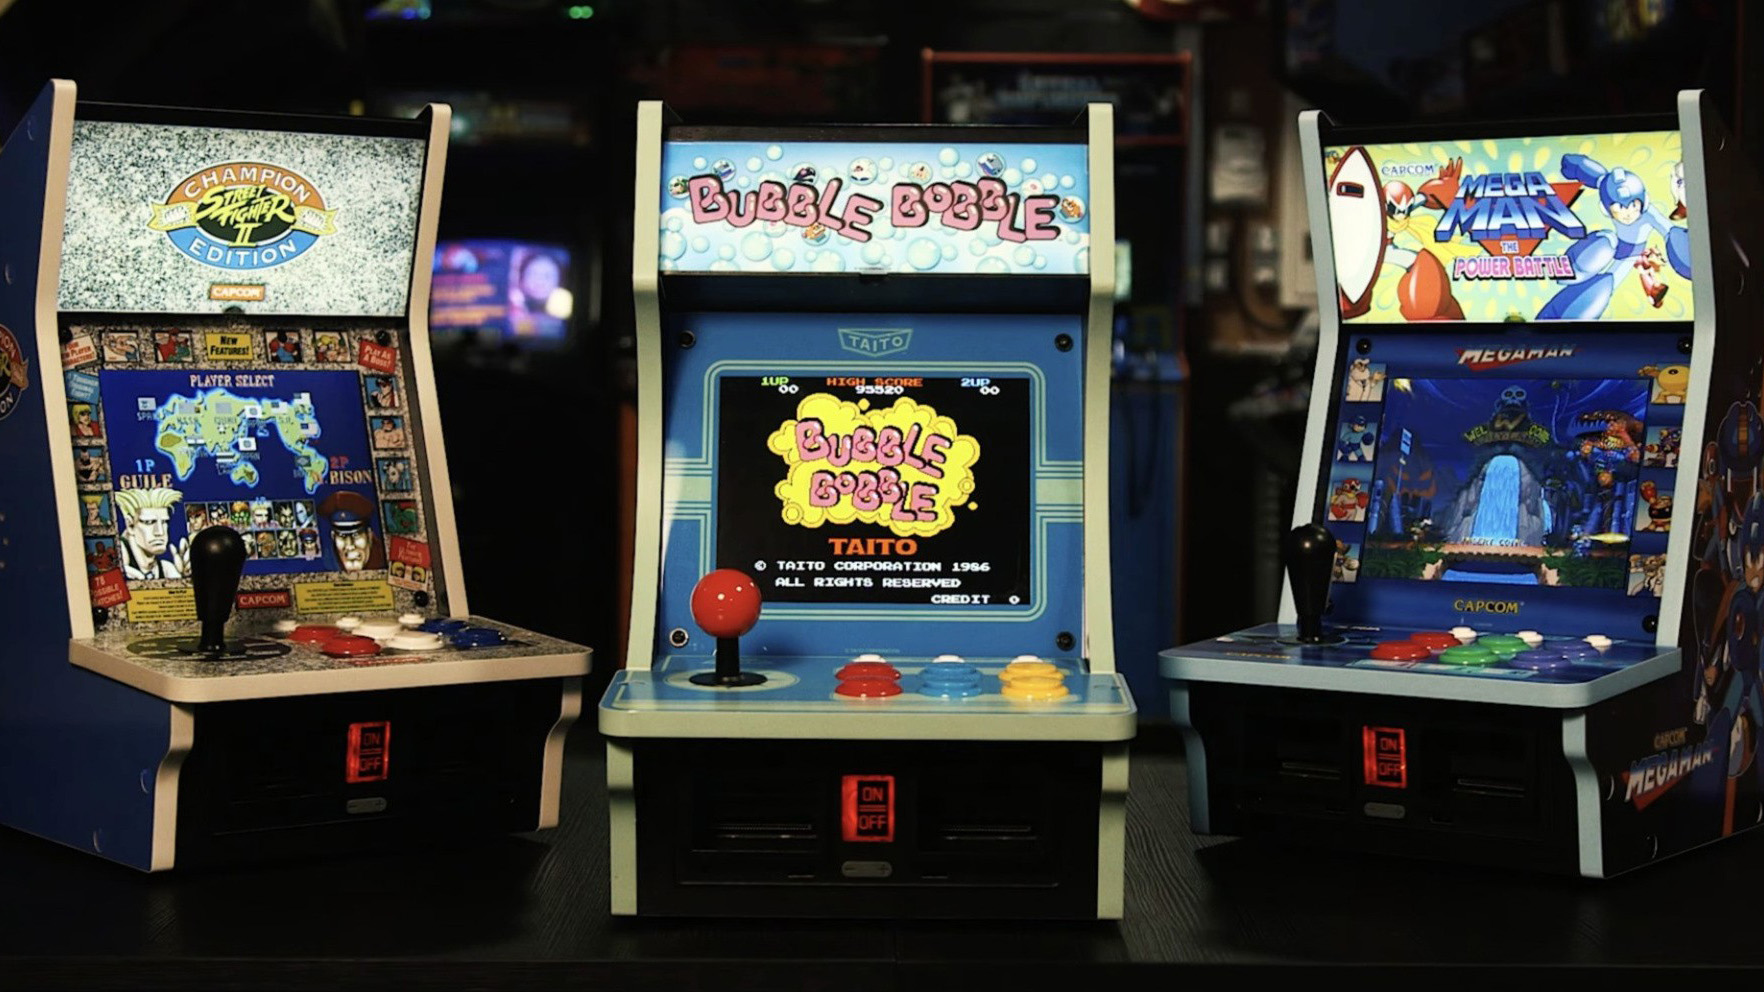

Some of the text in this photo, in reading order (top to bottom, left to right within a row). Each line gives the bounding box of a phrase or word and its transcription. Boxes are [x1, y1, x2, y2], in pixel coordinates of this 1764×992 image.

[1381, 162, 1435, 177] CAPCOM
[184, 166, 311, 203] CHAMPION
[1454, 171, 1557, 199] MEGA
[196, 184, 268, 220] STREET
[688, 173, 1061, 243] BUBBLE BOBBLE
[208, 193, 296, 228] FIGHTER
[1434, 197, 1587, 242] MAN
[228, 223, 263, 247] II
[189, 239, 297, 267] EDITION
[1501, 241, 1519, 254] THE
[1454, 256, 1575, 280] POWER BATTLE
[211, 286, 261, 299] CAPCOM
[220, 335, 238, 346] NEW
[848, 335, 904, 353] TAITO
[210, 344, 250, 356] FEATURES!
[189, 374, 275, 388] PLAYER SELECT
[761, 376, 789, 386] 1UP
[826, 377, 923, 387] HIGH SCORE
[961, 377, 991, 388] 2UP
[778, 385, 799, 395] 00
[980, 385, 1000, 395] 00
[795, 417, 953, 479] BUBBLE
[135, 459, 155, 473] 1P
[329, 455, 350, 469] 2P
[119, 473, 174, 489] GUILE
[329, 469, 373, 485] BISON
[809, 466, 940, 523] BOBBLE
[828, 537, 918, 556] TAITO
[776, 560, 826, 571] TAITO
[833, 560, 942, 573] CORPORATION
[951, 561, 990, 573] 1986
[775, 577, 962, 589] ALL RIGHTS RESERVED
[239, 594, 286, 606] CAPCOM
[930, 594, 1020, 605] CREDIT 0
[1454, 599, 1518, 614] CAPCOM
[363, 732, 381, 746] ON
[1380, 737, 1398, 751] ON
[359, 757, 382, 772] OFF
[1378, 762, 1401, 776] OFF
[862, 787, 884, 802] ON
[858, 814, 888, 830] OFF
